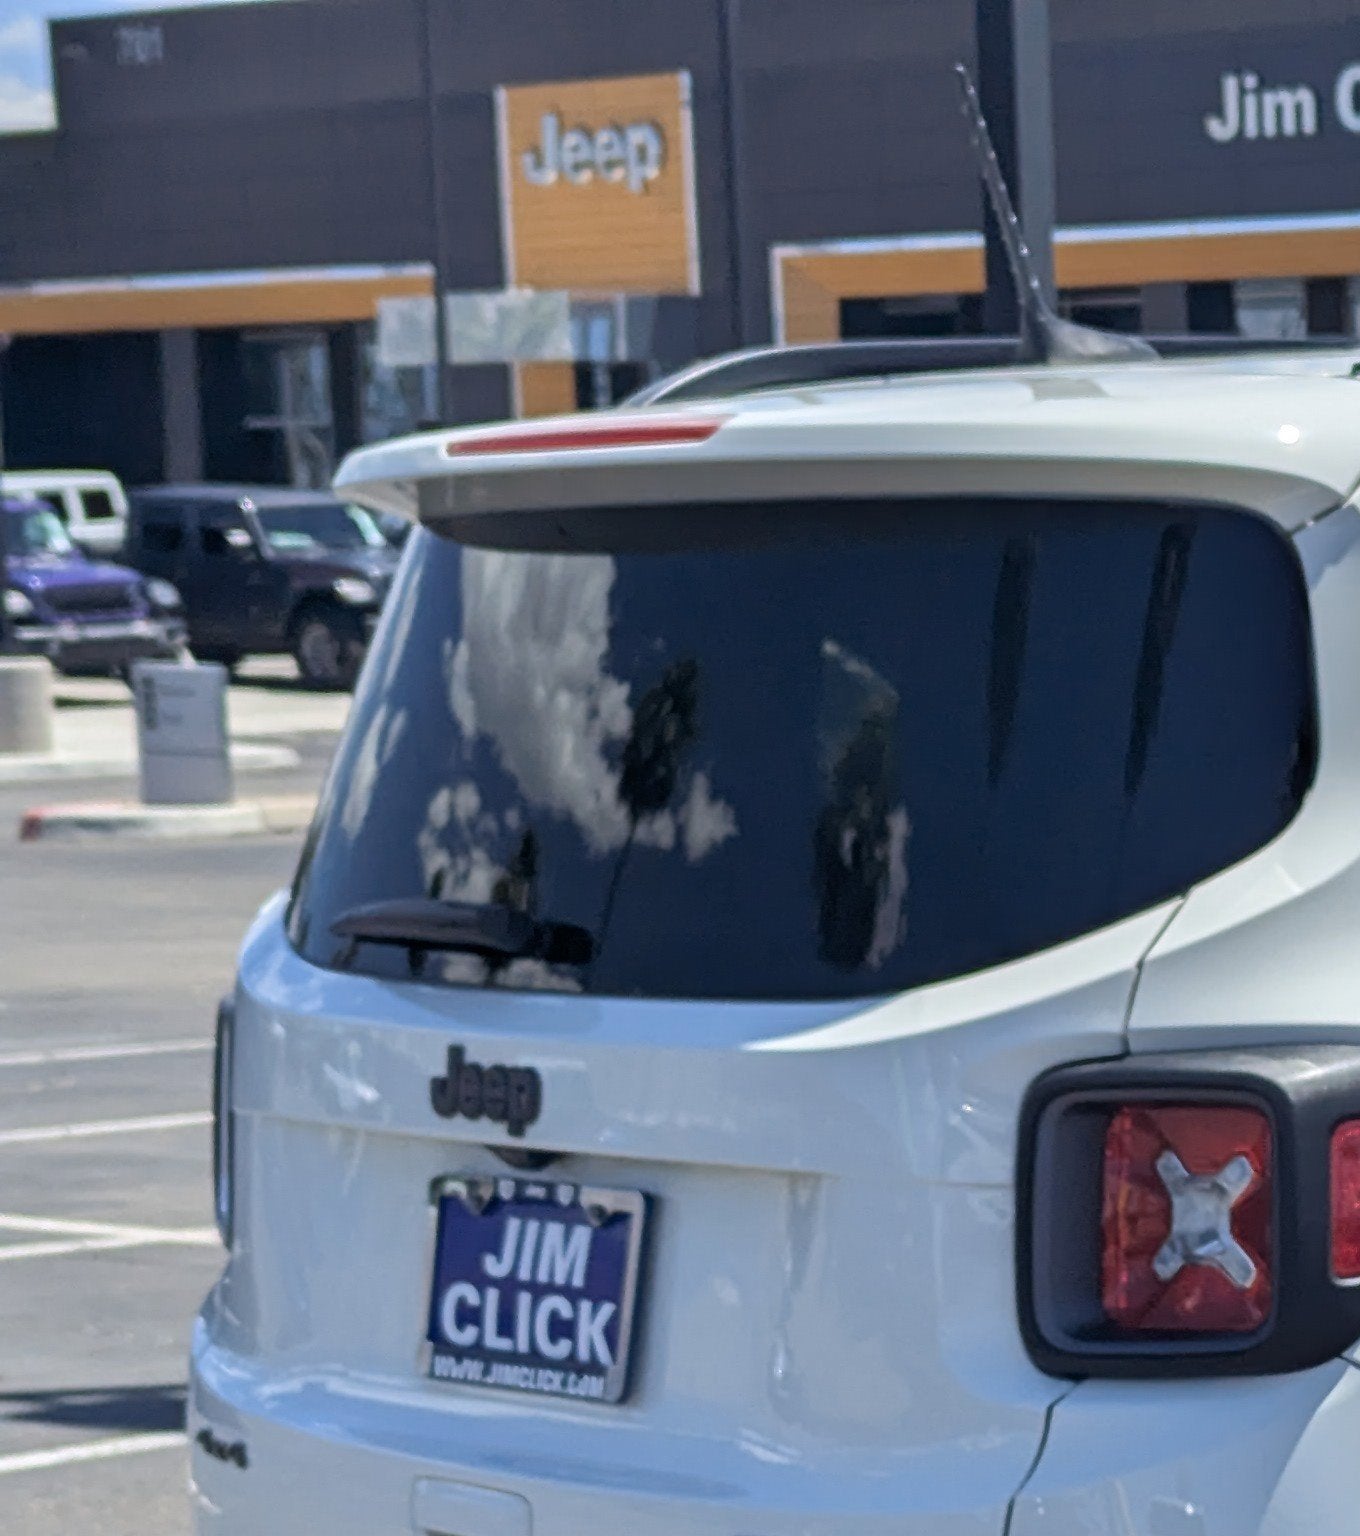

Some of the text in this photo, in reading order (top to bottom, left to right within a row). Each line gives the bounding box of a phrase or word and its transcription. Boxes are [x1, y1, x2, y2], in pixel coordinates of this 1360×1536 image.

[1204, 72, 1317, 142] Jim
[523, 112, 661, 193] Jeep
[429, 1043, 542, 1138] Jeep
[482, 1216, 593, 1289] JIM
[441, 1281, 617, 1368] CLICK
